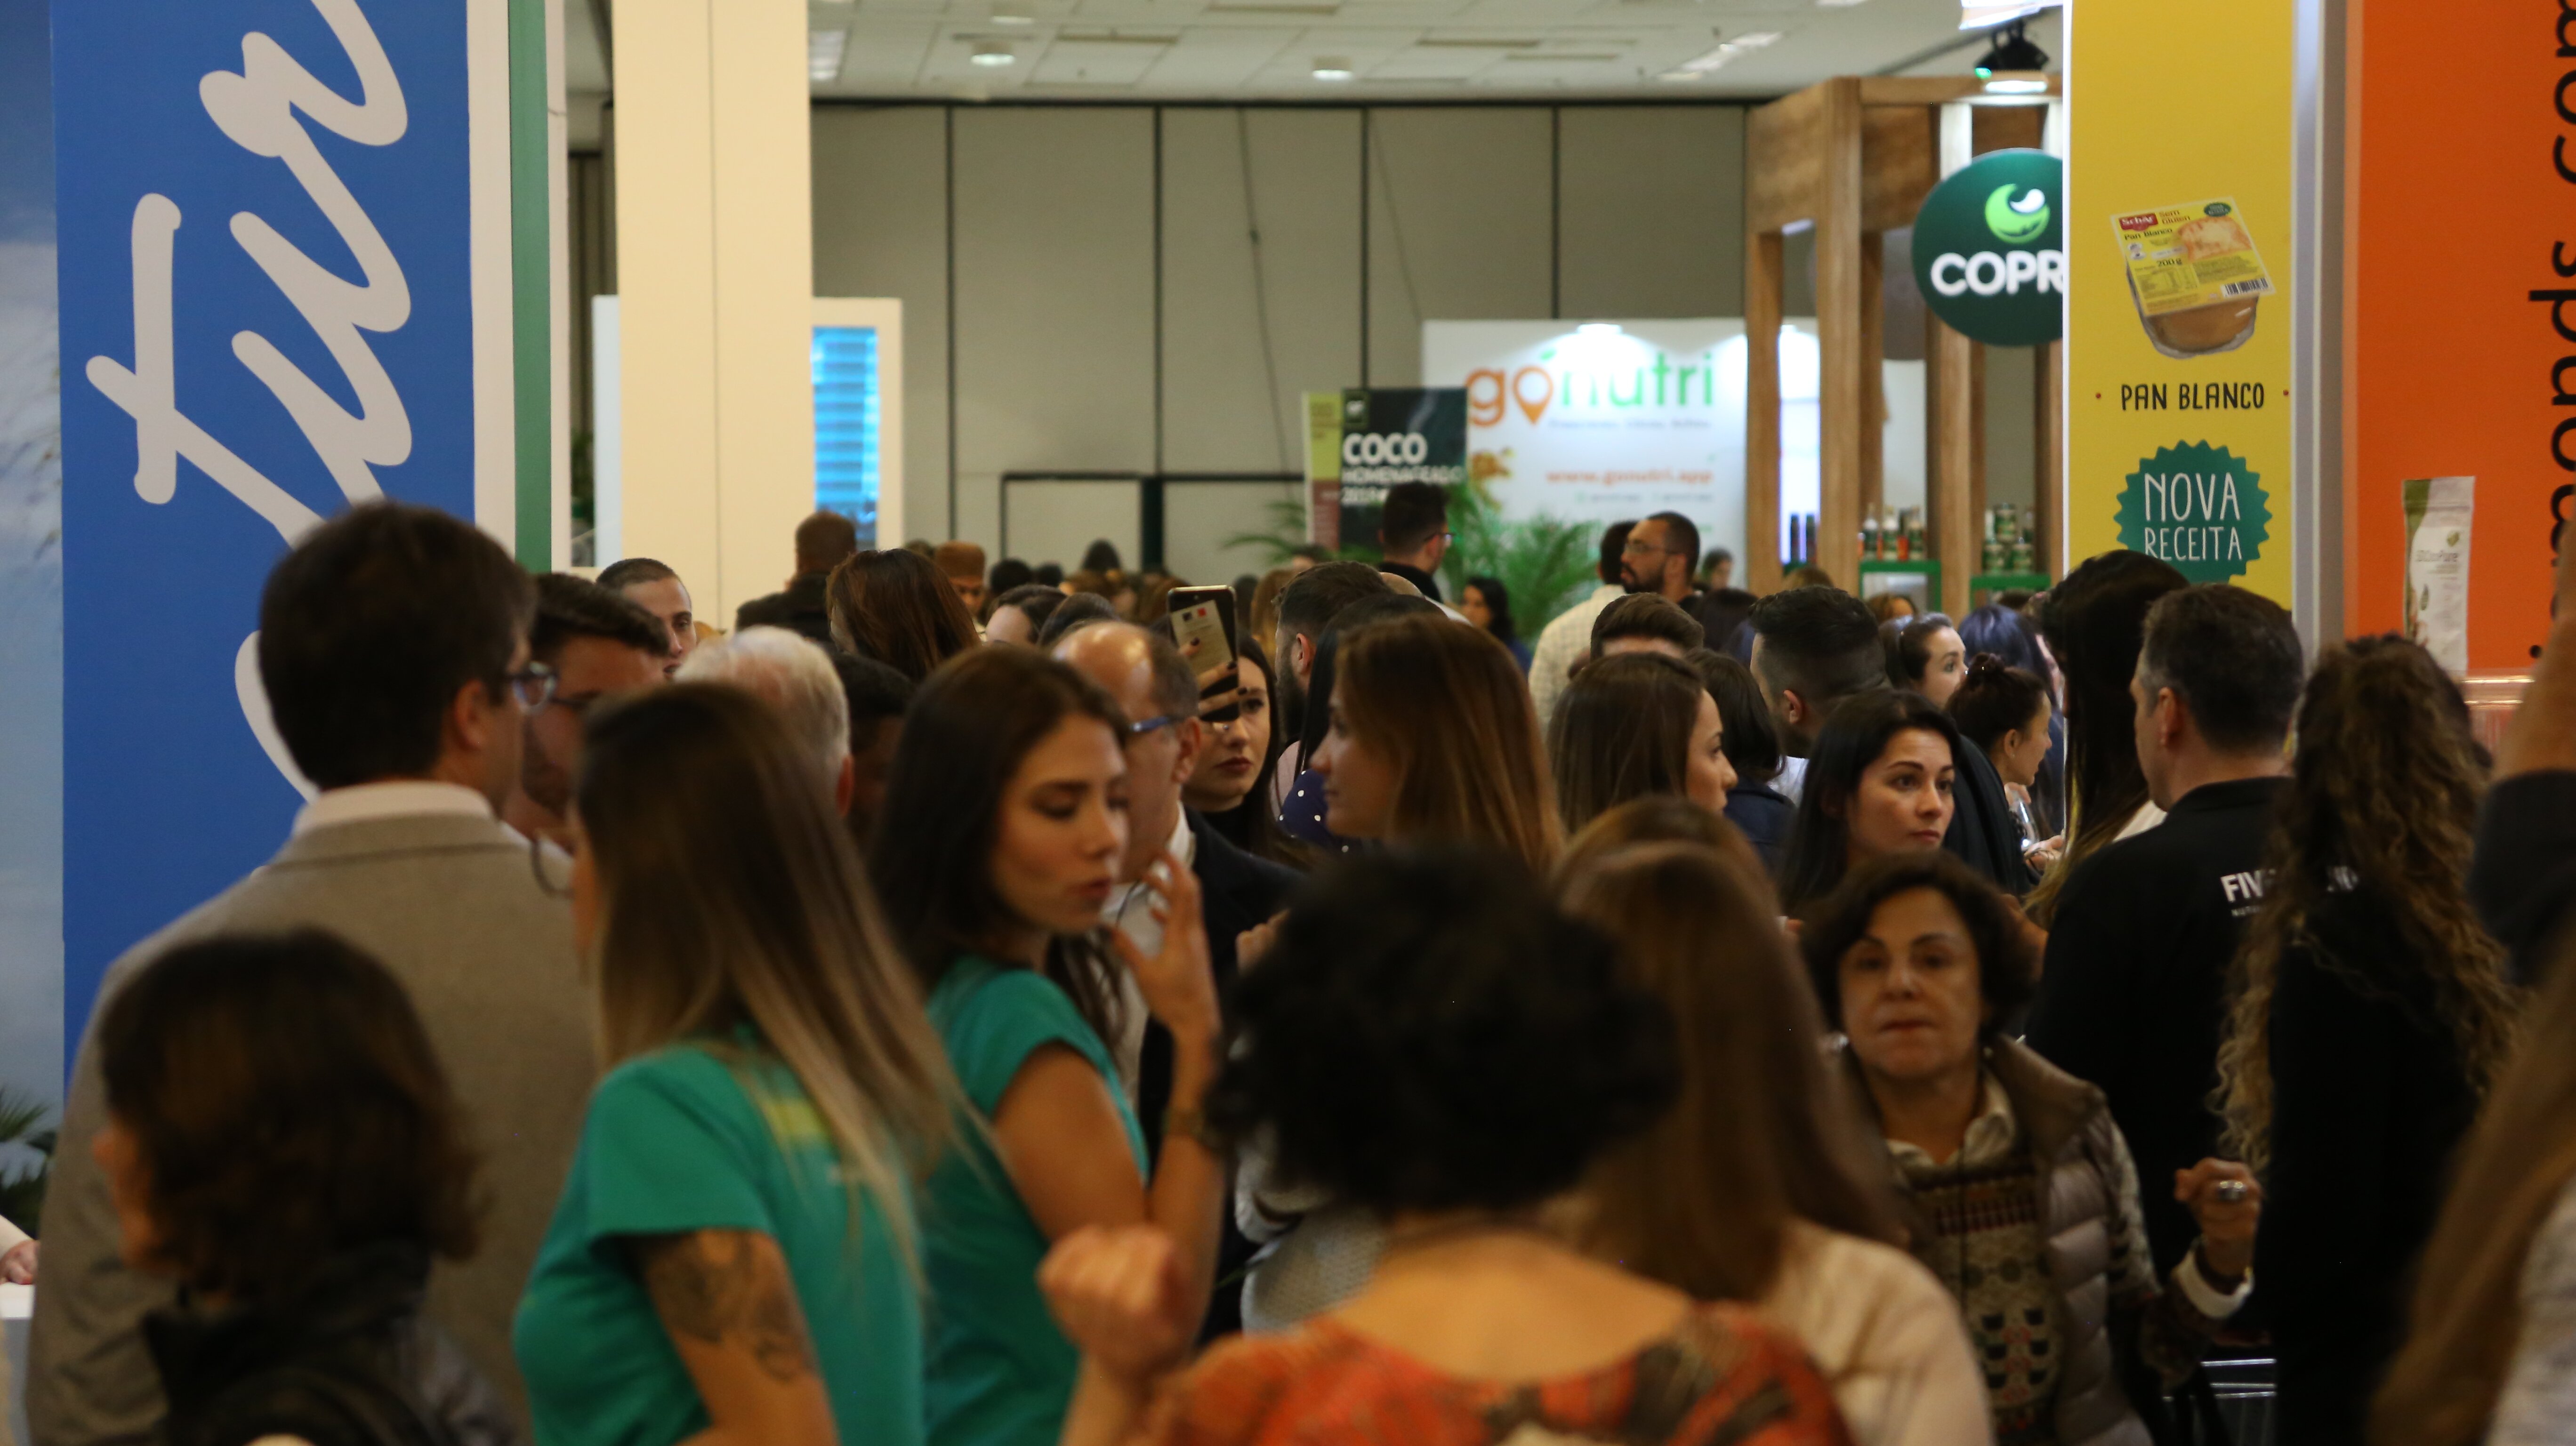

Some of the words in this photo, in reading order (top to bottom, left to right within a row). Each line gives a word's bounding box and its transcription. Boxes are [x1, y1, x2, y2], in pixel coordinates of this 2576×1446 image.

[1931, 249, 2063, 297] COPR
[86, 0, 411, 801] tur
[2121, 383, 2167, 410] PAN
[2179, 382, 2264, 410] BLANCO
[1343, 432, 1427, 466] COCO
[2144, 472, 2240, 522] NOVA
[2145, 526, 2243, 561] RECEITA
